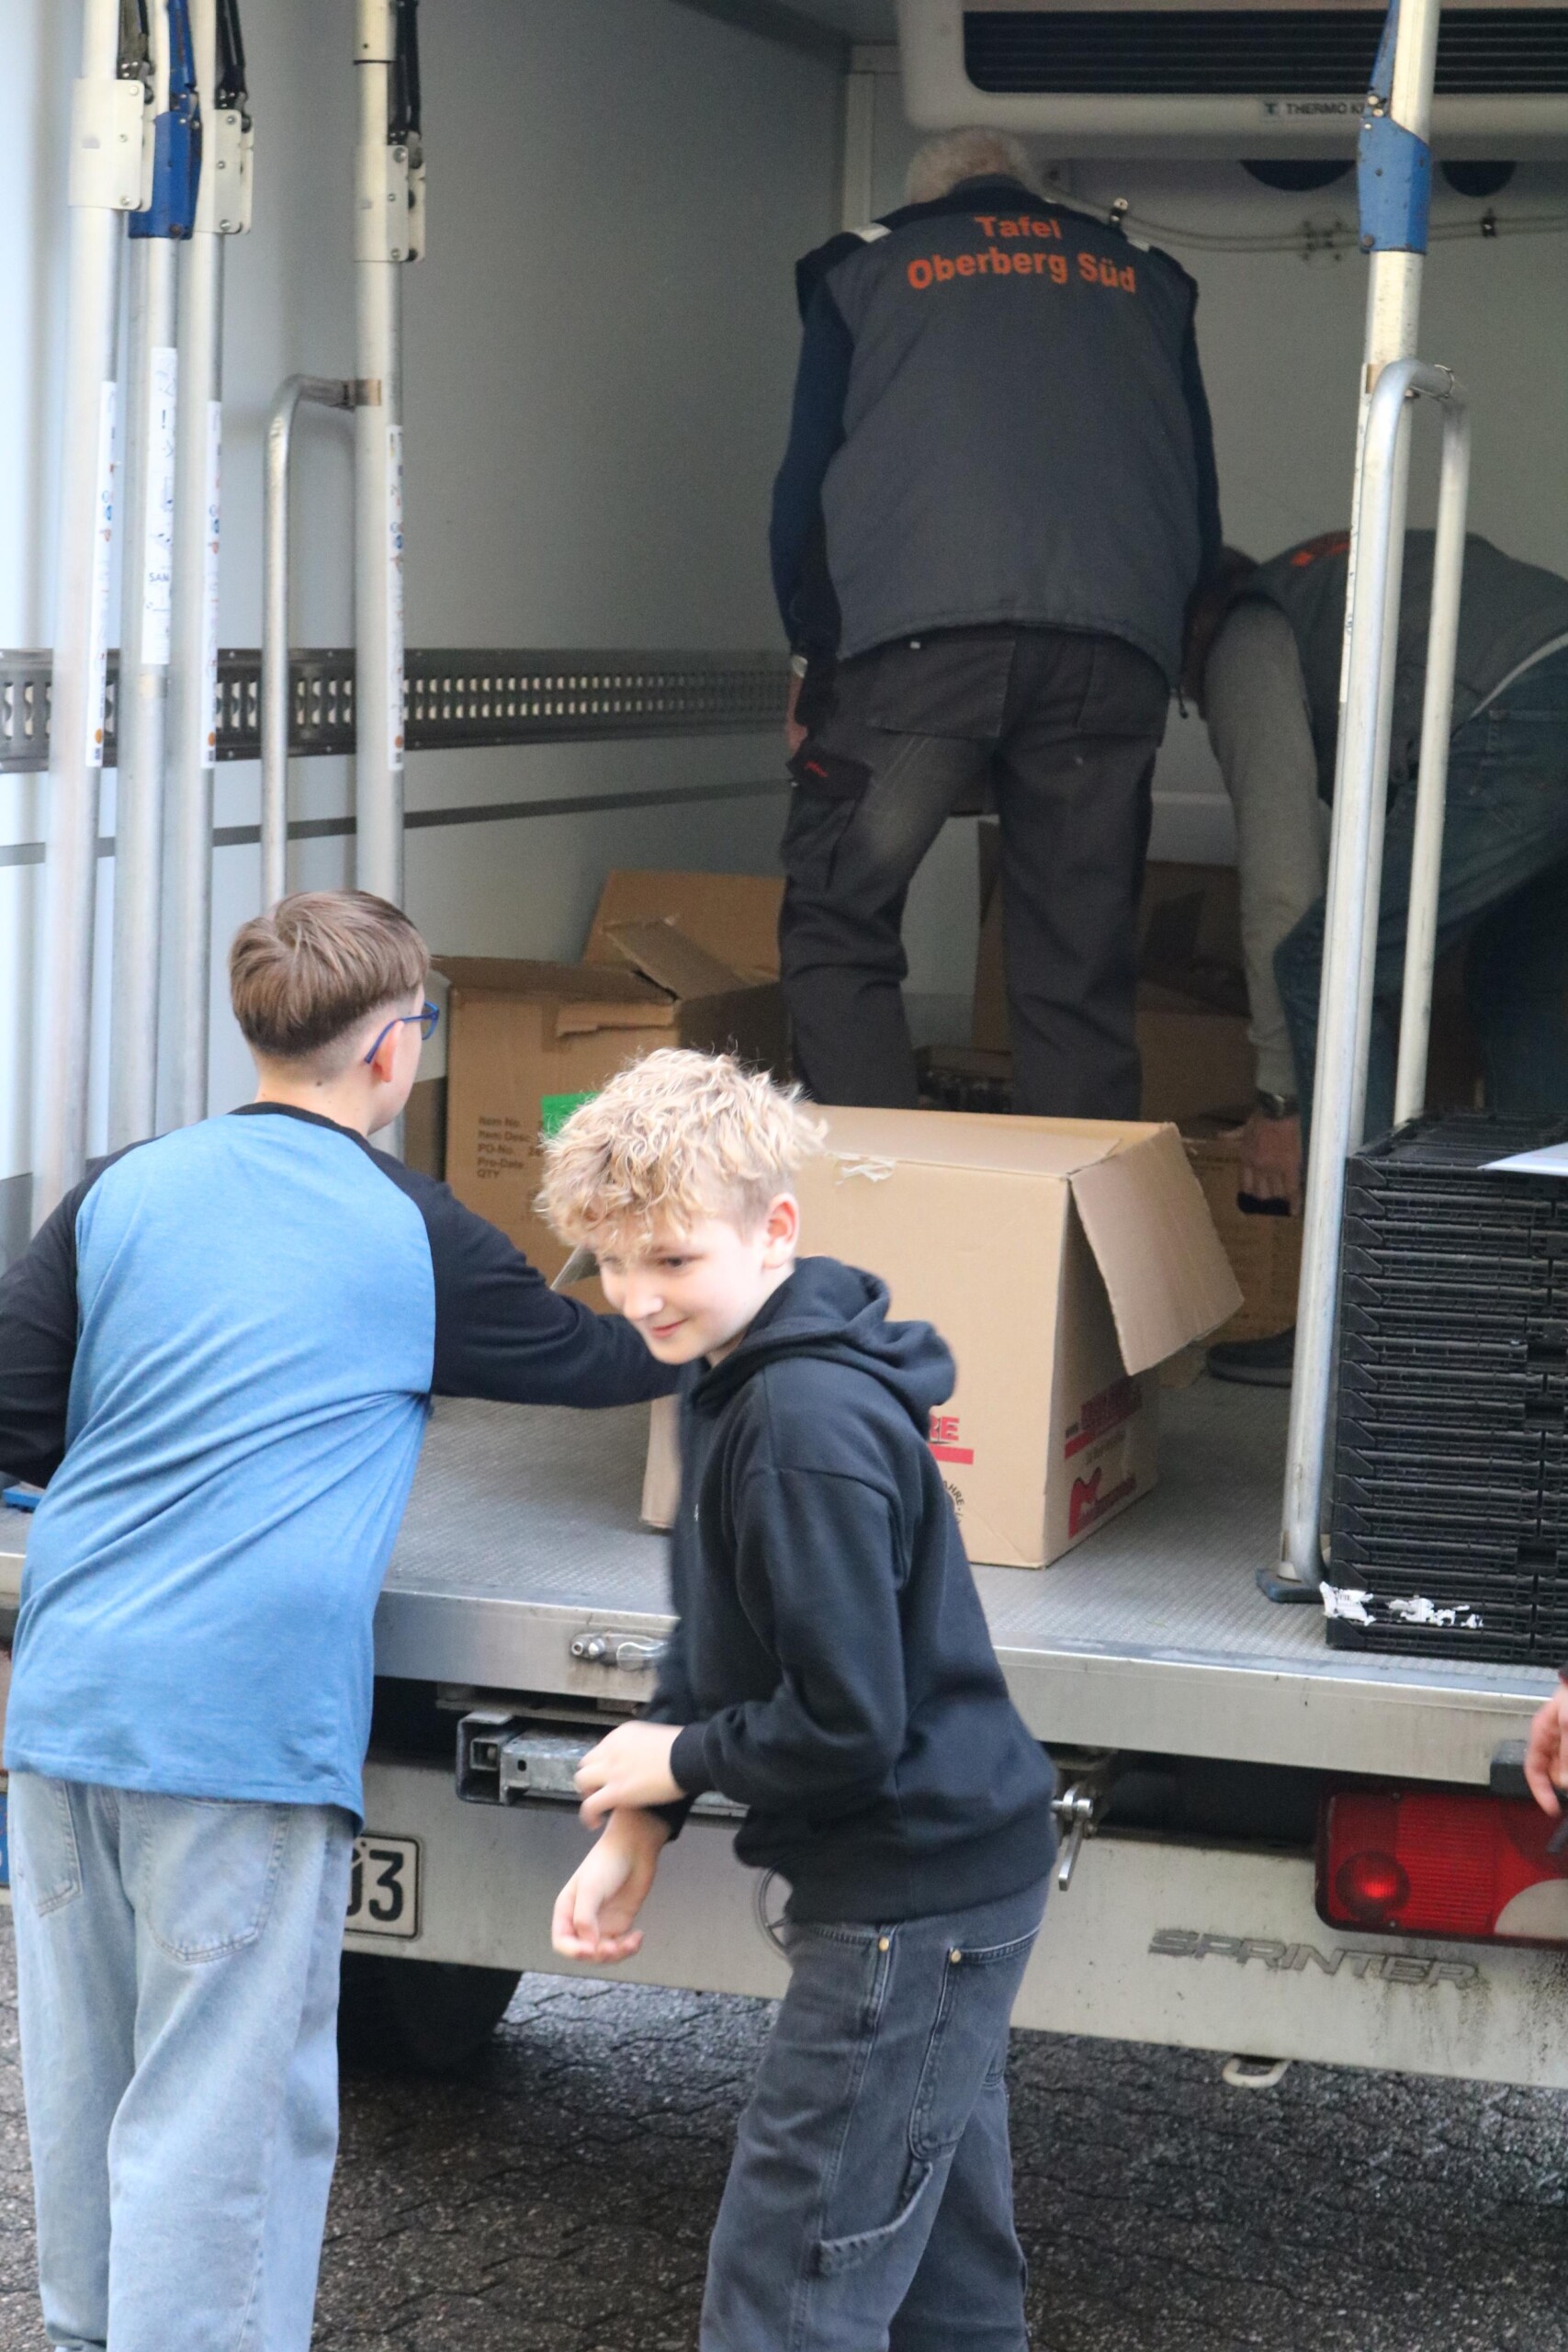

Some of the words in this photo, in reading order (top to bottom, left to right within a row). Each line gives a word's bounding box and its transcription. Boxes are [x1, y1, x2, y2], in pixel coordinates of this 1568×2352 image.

[1286, 102, 1348, 115] THERMO
[974, 215, 1063, 241] Tafel
[907, 245, 1069, 290] Oberberg
[1077, 252, 1136, 294] Süd
[477, 1169, 500, 1179] QTY
[1148, 1929, 1477, 1990] SPRINTER
